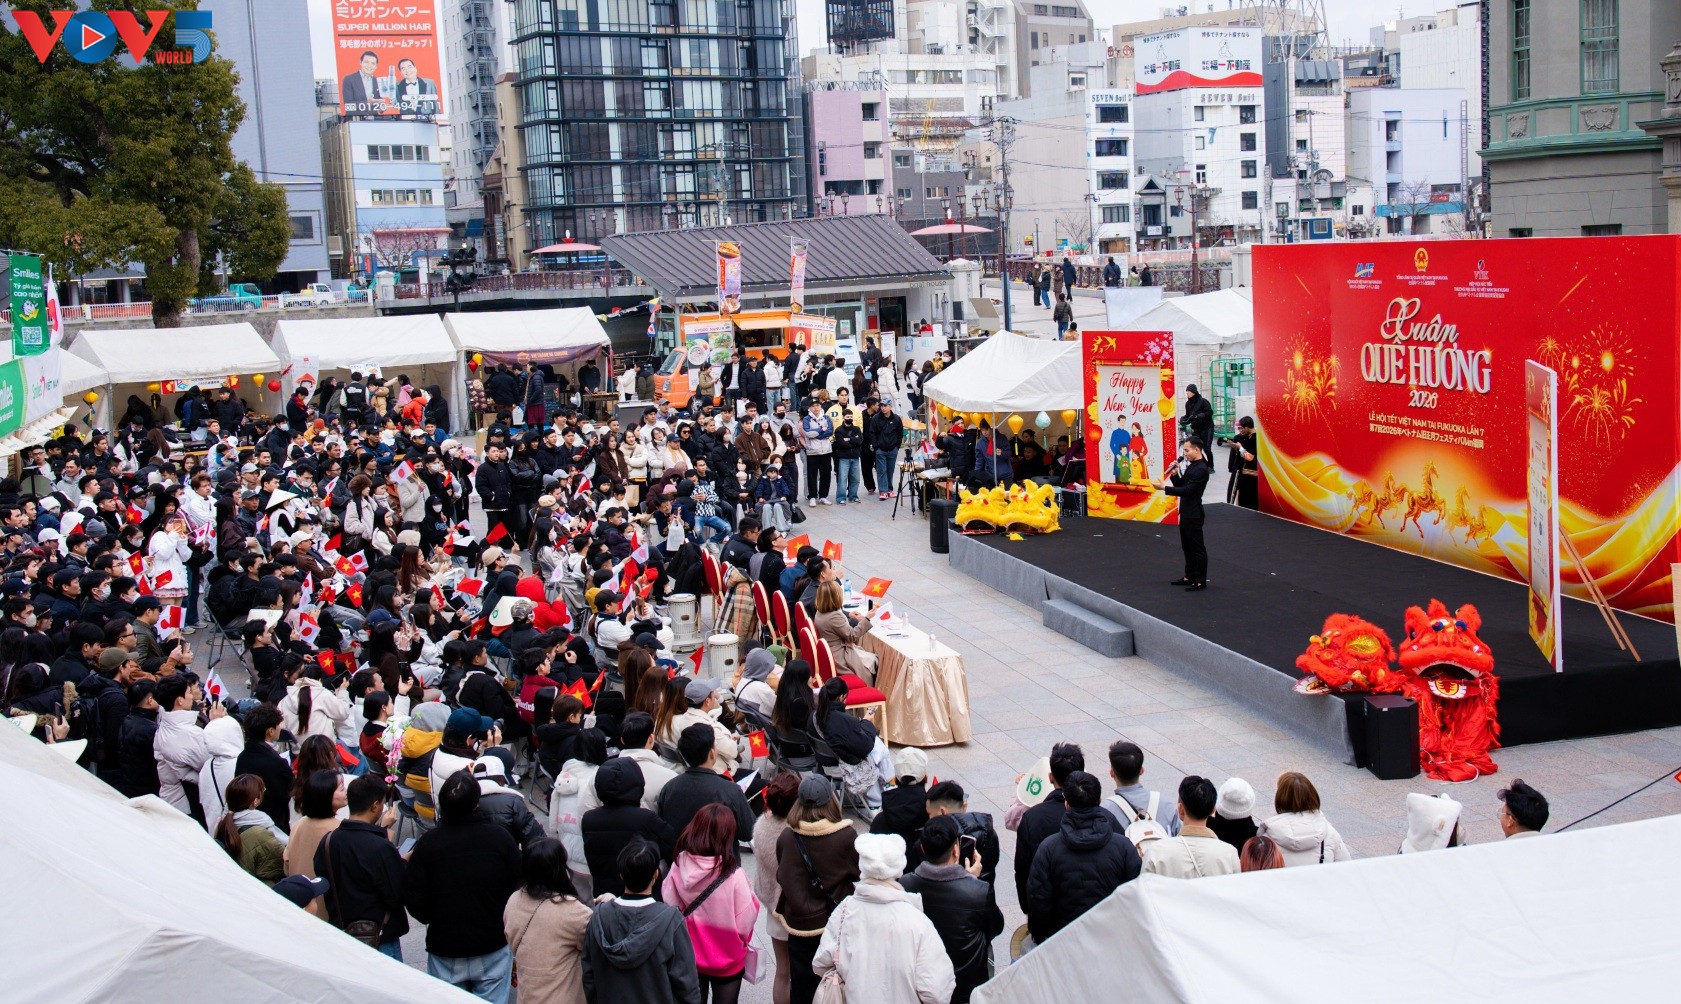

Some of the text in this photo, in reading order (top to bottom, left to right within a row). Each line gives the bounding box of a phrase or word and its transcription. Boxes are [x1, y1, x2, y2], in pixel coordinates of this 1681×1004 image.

[336, 6, 431, 18] ミリオンヘアー
[337, 23, 431, 31] SUPER MILLION HAIR
[1210, 60, 1251, 70] 福一不動産
[1092, 94, 1114, 103] SEVEN
[1201, 93, 1232, 102] SEVEN
[13, 267, 40, 279] Smiles
[1381, 297, 1459, 344] Xuân
[1361, 336, 1492, 394] QUÊ HƯƠNG
[1109, 372, 1147, 394] Happy
[1103, 394, 1155, 415] New Year
[1408, 390, 1439, 409] 2026
[1412, 418, 1427, 428] NAM
[1437, 422, 1466, 434] FUKUOKA
